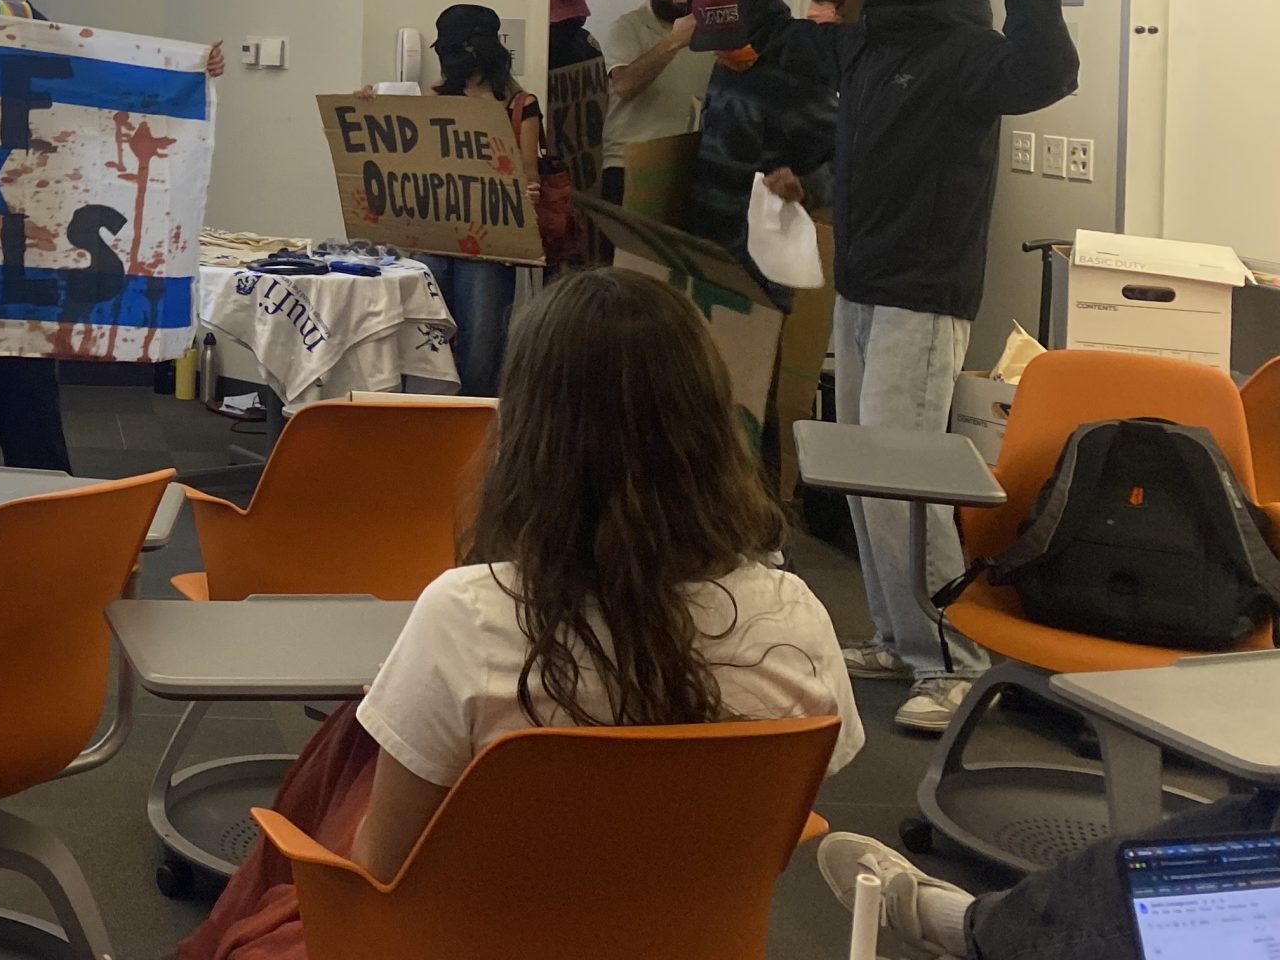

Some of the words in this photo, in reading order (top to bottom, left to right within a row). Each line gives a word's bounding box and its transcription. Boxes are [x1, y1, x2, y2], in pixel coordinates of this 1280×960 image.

[698, 4, 739, 25] VANS
[334, 106, 418, 154] END
[430, 118, 493, 161] THE
[363, 160, 526, 228] OCCUPATION
[1079, 255, 1113, 267] BASIC
[1115, 259, 1147, 270] DUTY
[1076, 302, 1119, 312] CONTENTS
[957, 415, 988, 428] CONTENTS
